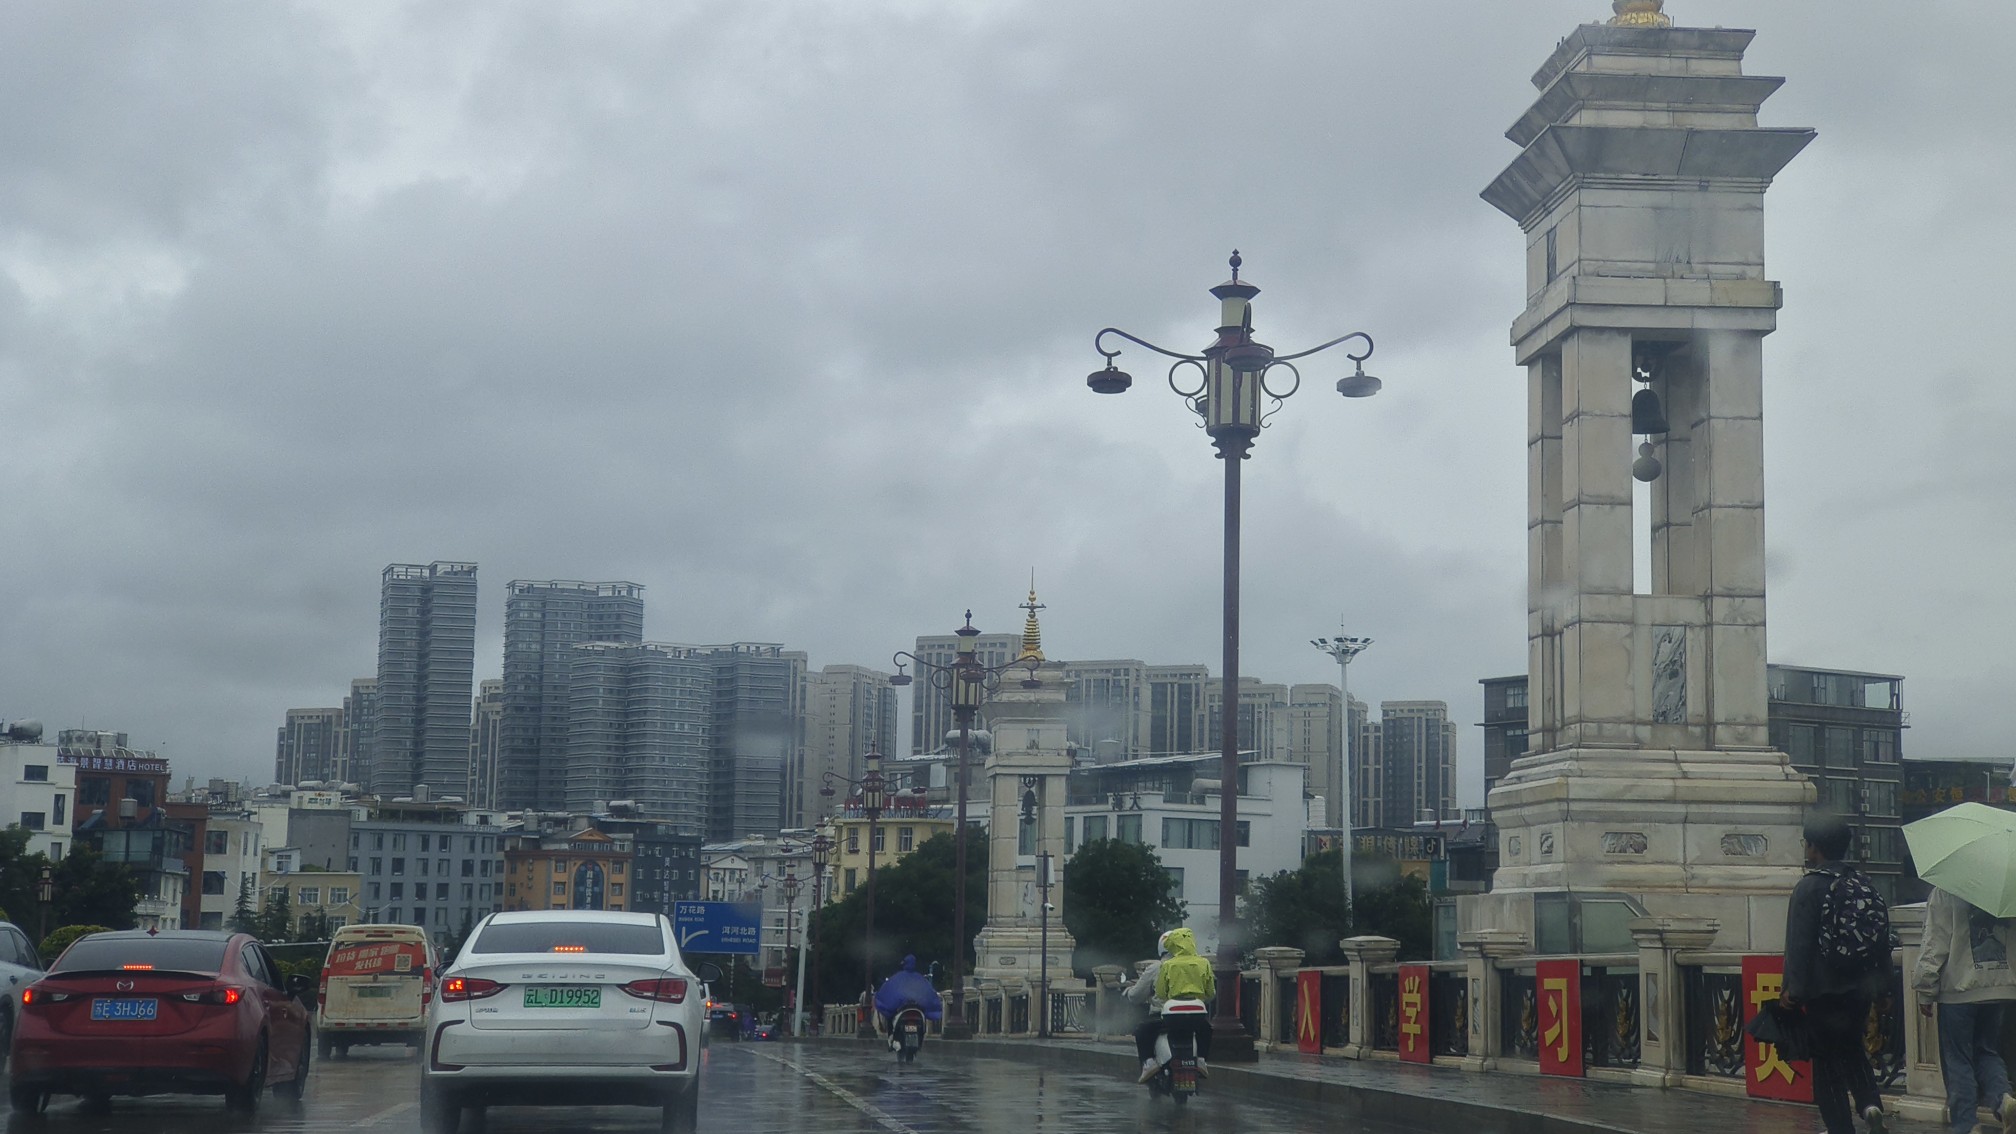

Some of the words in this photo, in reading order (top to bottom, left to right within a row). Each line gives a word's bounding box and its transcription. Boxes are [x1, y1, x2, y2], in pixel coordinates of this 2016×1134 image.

[138, 763, 164, 771] HOTEL
[680, 905, 705, 915] 万花路
[722, 926, 756, 936] 洱河北路
[1402, 976, 1421, 1052] 学
[1544, 978, 1568, 1063] 习
